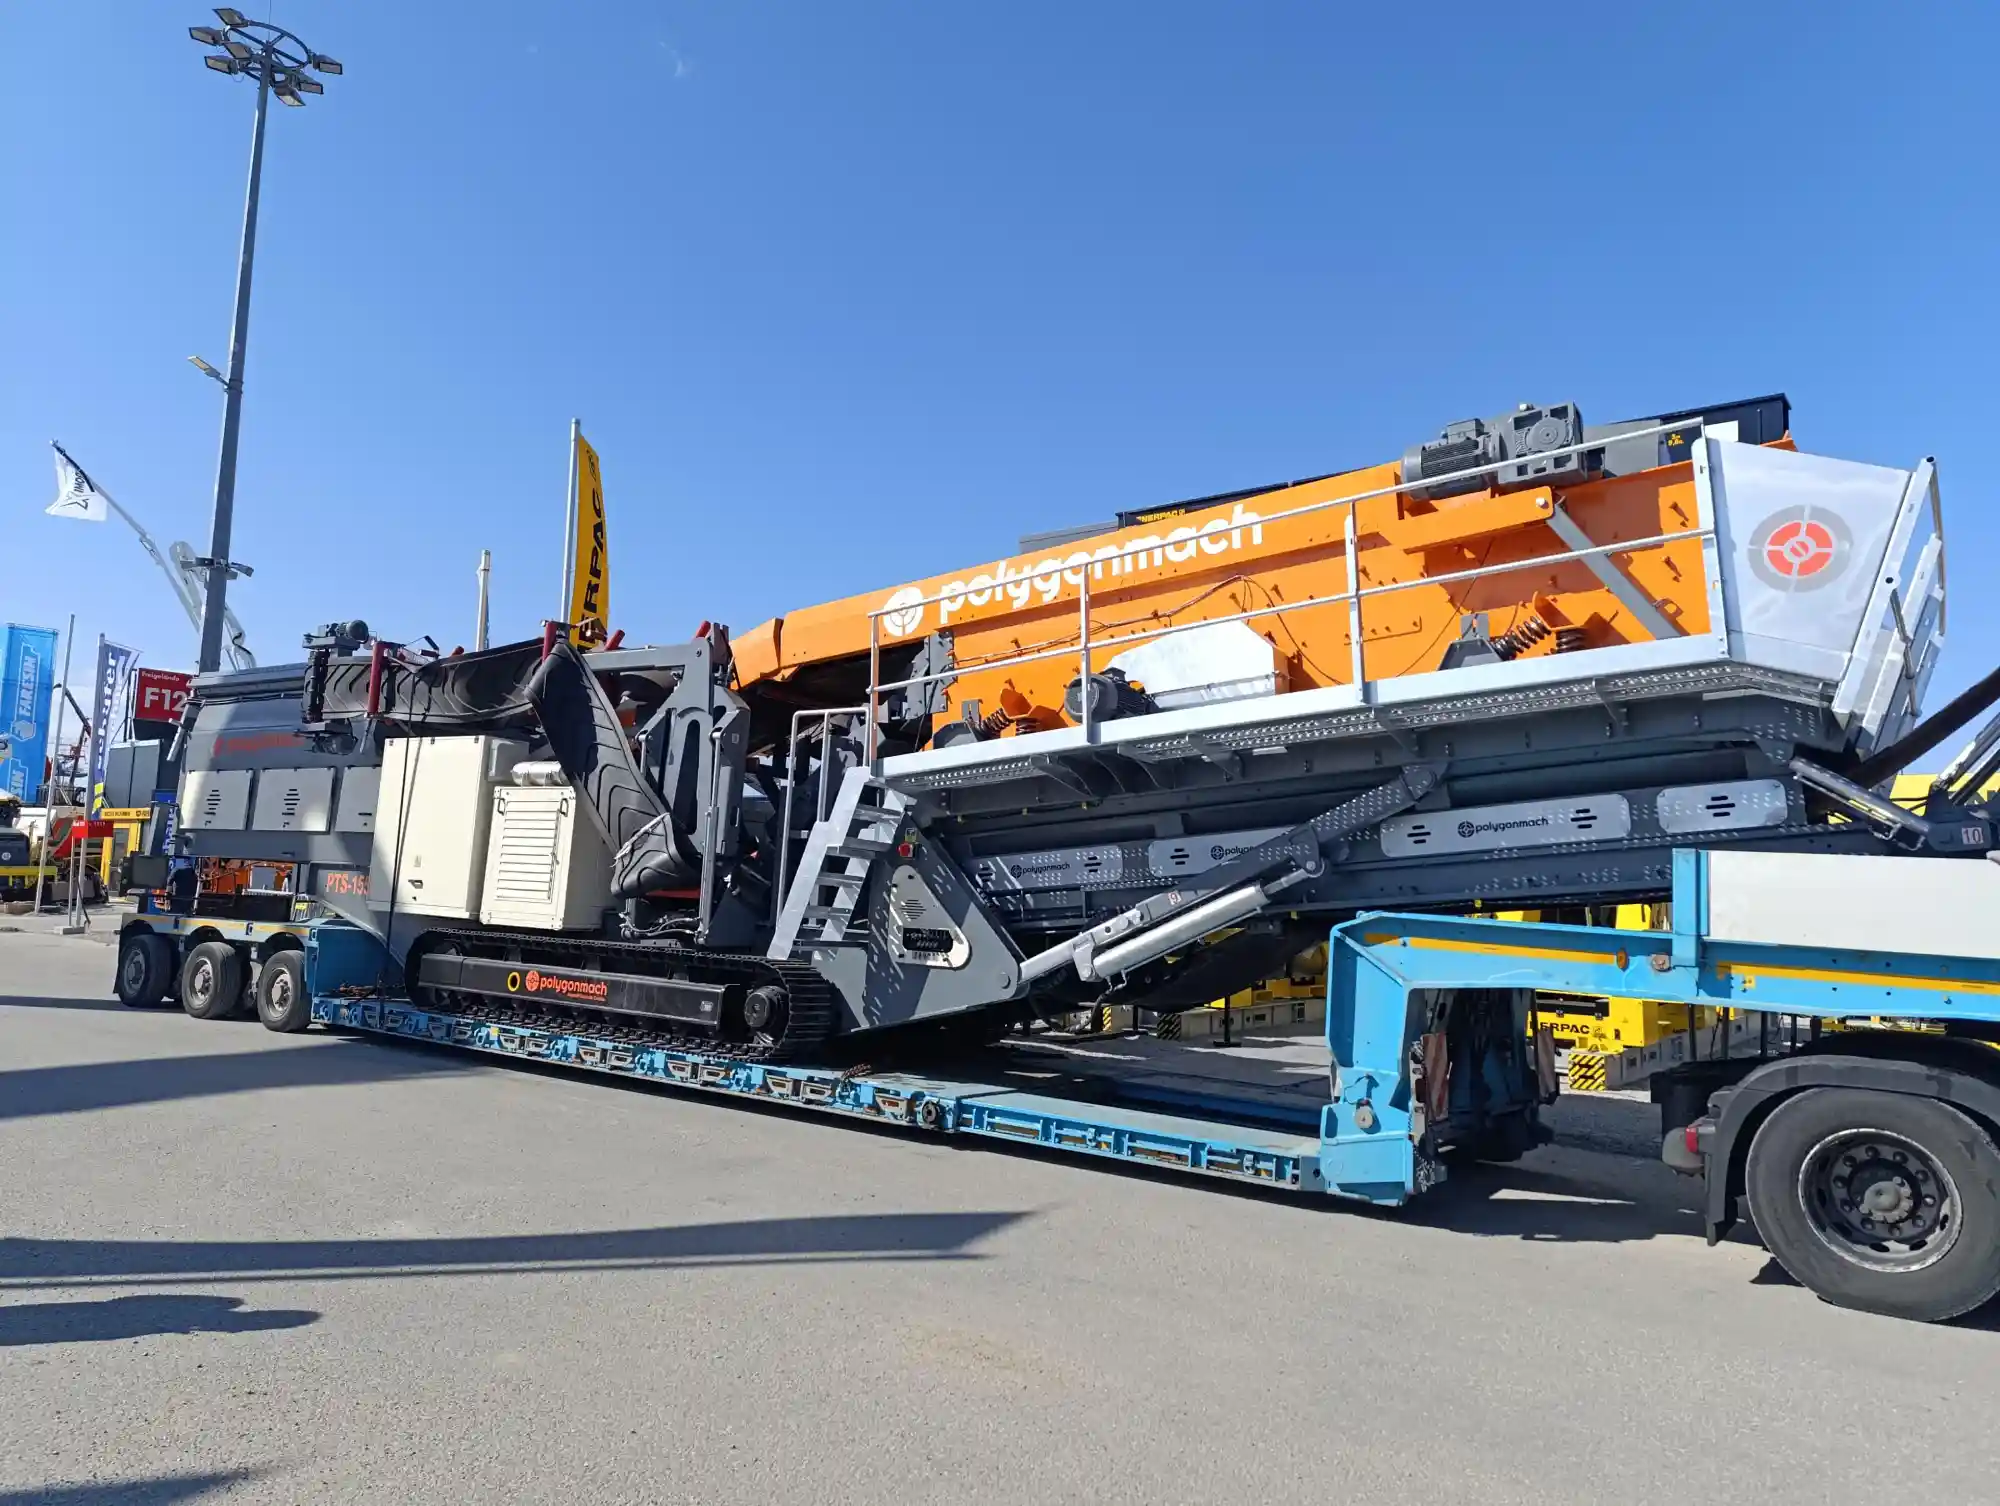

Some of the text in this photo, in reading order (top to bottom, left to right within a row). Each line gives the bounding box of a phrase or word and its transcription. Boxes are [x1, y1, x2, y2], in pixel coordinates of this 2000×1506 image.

[577, 487, 604, 654] ERPAC
[939, 504, 1263, 624] polygonmach
[144, 687, 187, 712] F12
[1475, 817, 1549, 834] polygonmach
[1022, 862, 1071, 875] polygonmach
[539, 976, 608, 996] polygonmach
[1530, 1021, 1590, 1035] ERPAC
